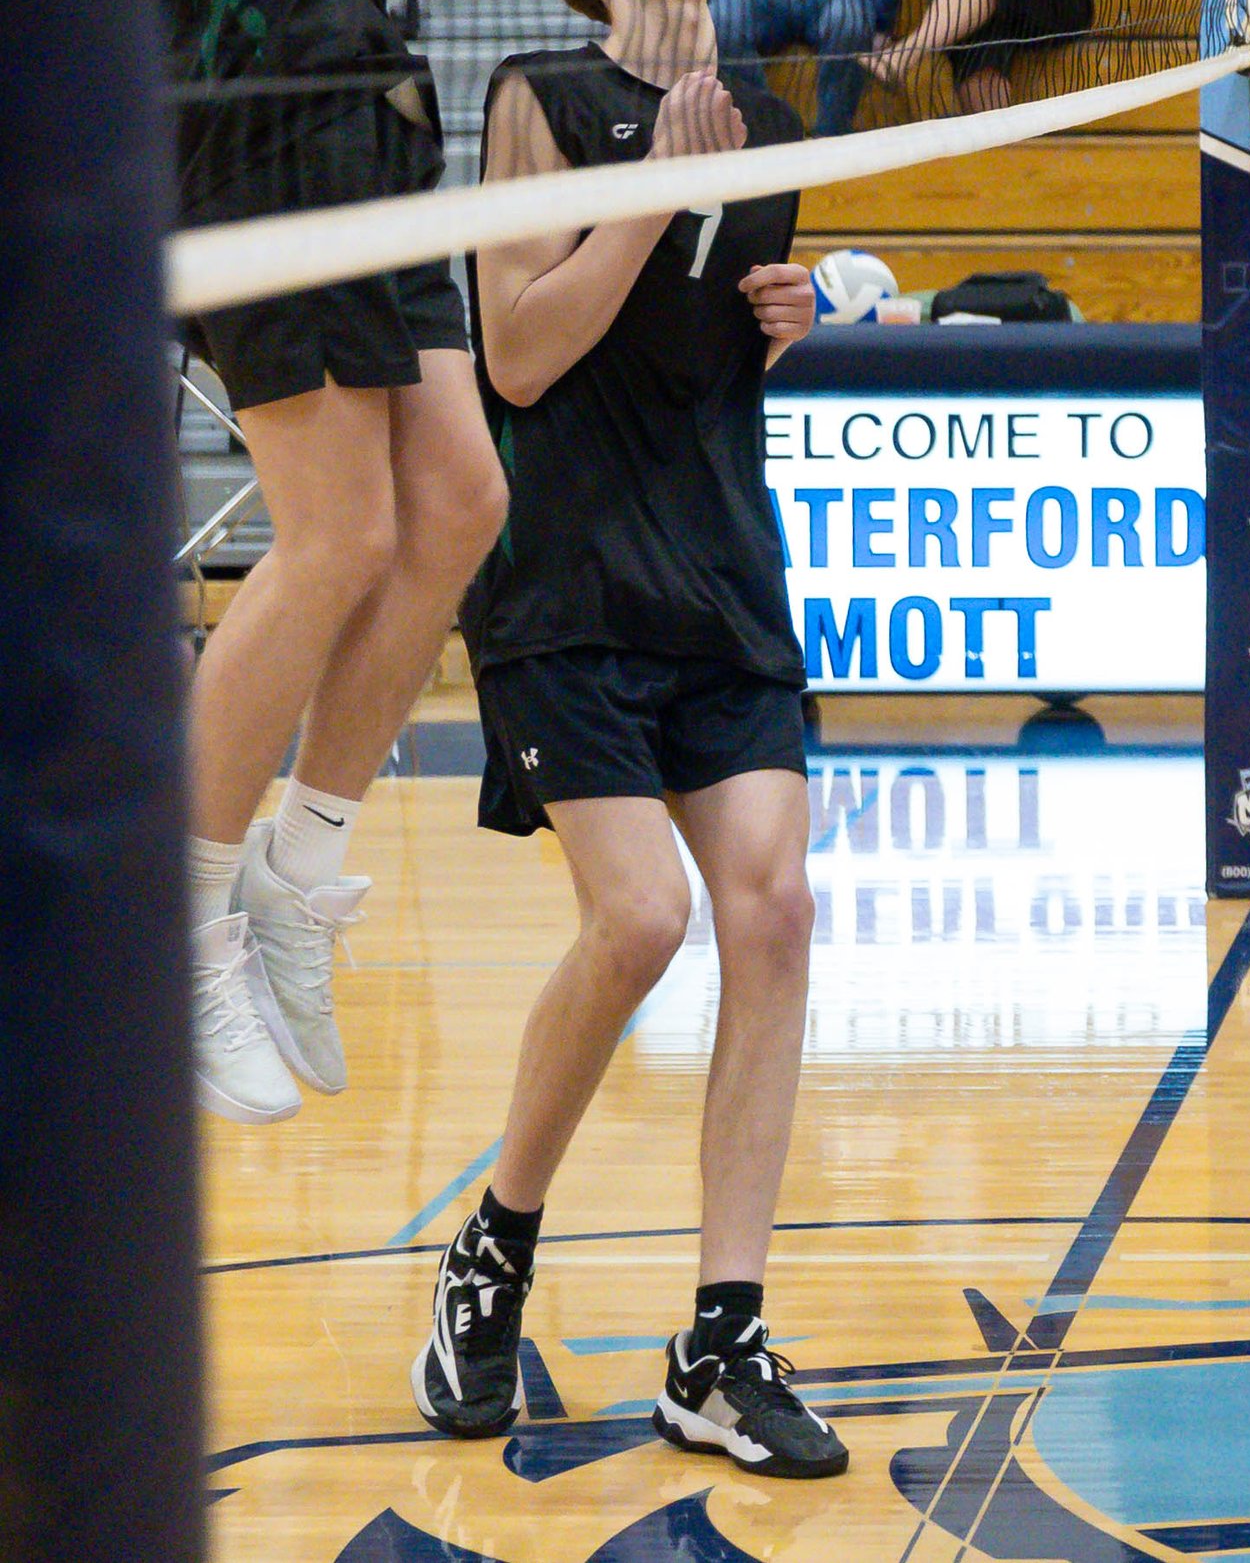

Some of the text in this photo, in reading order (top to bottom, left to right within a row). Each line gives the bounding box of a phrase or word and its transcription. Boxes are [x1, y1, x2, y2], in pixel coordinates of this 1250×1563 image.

[765, 411, 1154, 460] ELCOME TO
[768, 485, 1207, 569] TERFORD
[803, 595, 1052, 681] MOTT
